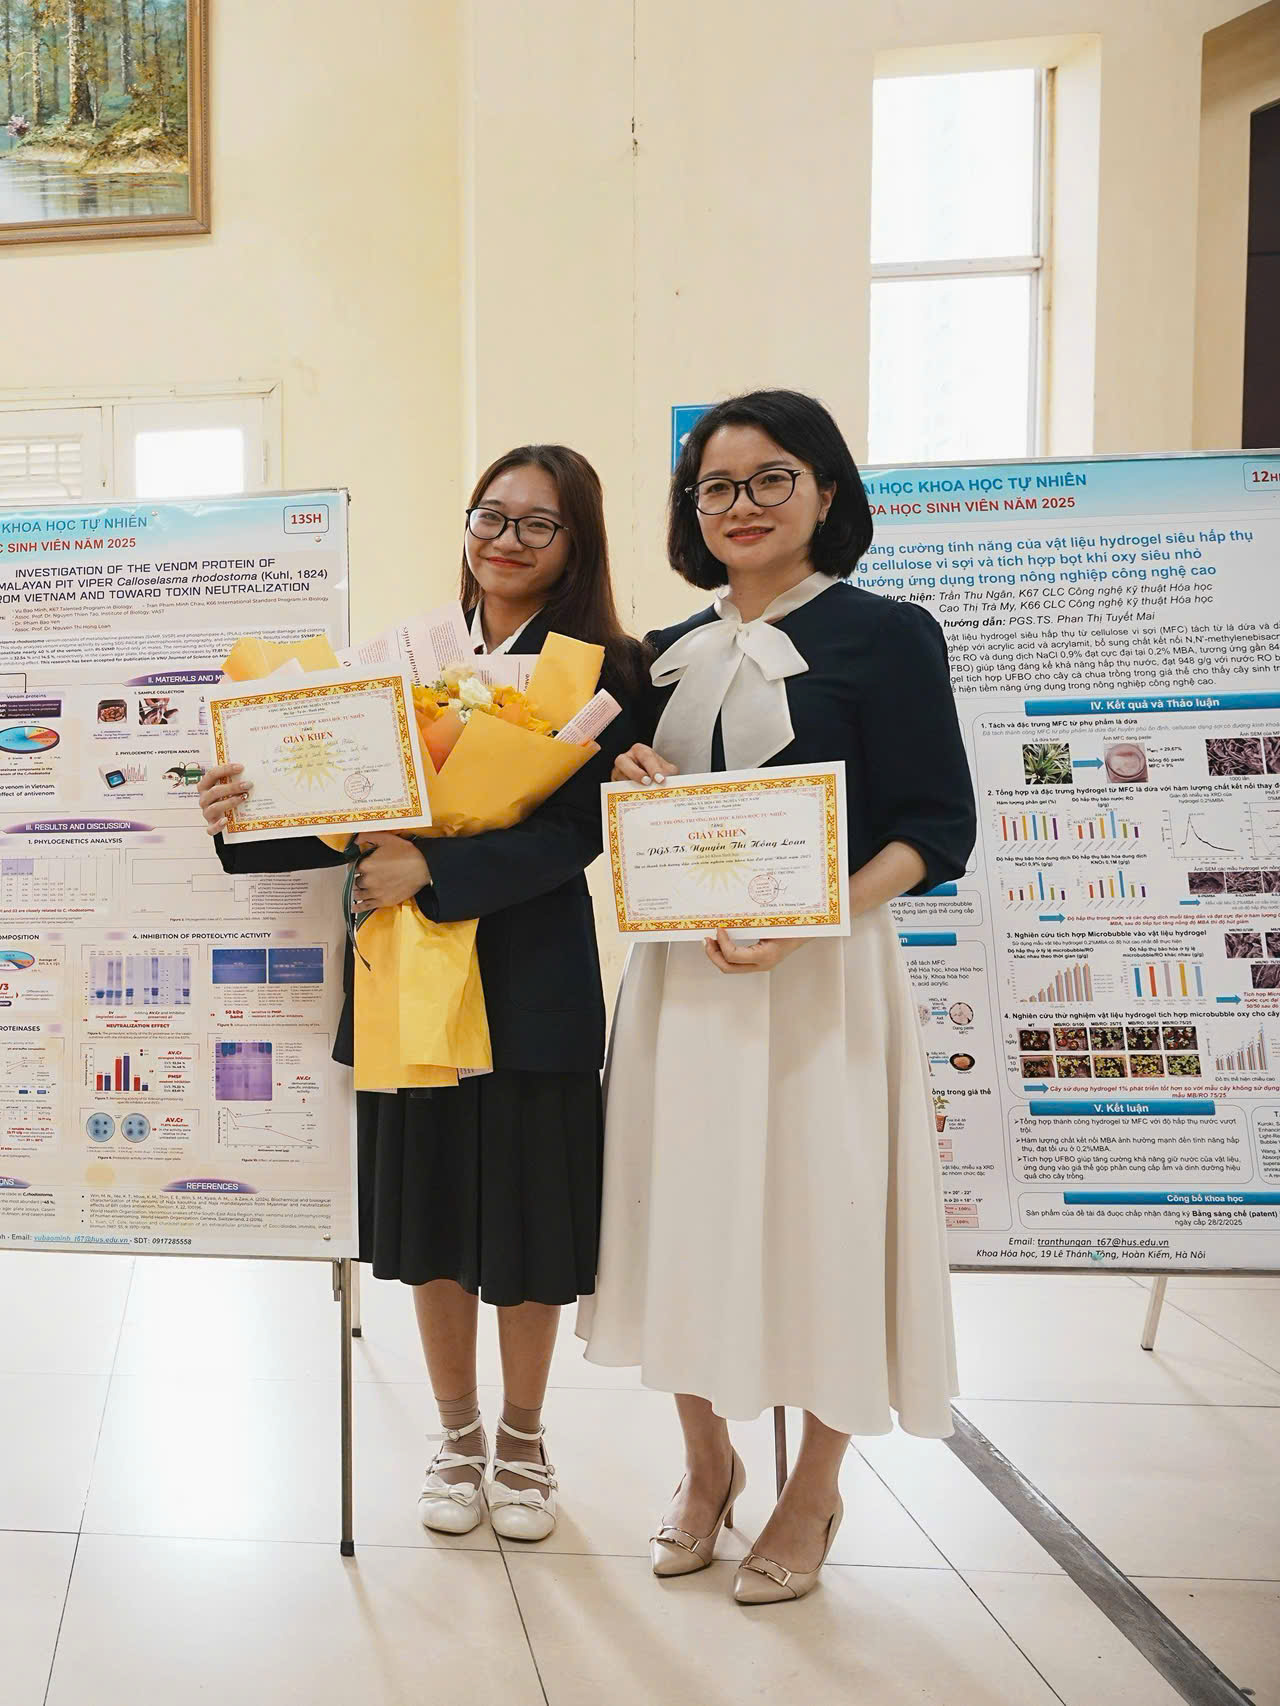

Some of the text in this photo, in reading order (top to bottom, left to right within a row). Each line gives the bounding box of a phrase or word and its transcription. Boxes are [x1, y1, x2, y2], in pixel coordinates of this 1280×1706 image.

[1252, 471, 1280, 482] 12H
[2, 522, 41, 534] KHOA
[46, 520, 76, 534] HỌC
[80, 518, 100, 532] TỰ
[104, 514, 147, 528] NHIÊN
[291, 514, 322, 524] 13SH
[872, 548, 1202, 571] cellulose vi sợi và tích hợp bọt khí oxy siêu nhỏ
[16, 558, 275, 578] INVESTIGATION OF THE VENOM PROTEIN OF
[55, 579, 74, 589] PIT
[78, 578, 113, 588] VIPER
[117, 574, 188, 586] Calloselasma
[191, 572, 257, 583] rhodostoma
[261, 570, 292, 582] (Kuhl,
[297, 569, 328, 580] 1824)
[24, 592, 76, 602] VIETNAM
[80, 590, 105, 600] AND
[109, 588, 161, 599] TOWARD
[165, 586, 201, 597] TOXIN
[205, 582, 310, 595] NEUTRALIZATION
[1090, 698, 1220, 710] IV. Kết quả và Thảo luận
[308, 732, 333, 741] KHEN
[716, 829, 747, 839] KHEN
[647, 845, 687, 856] PGS.TS.
[781, 838, 806, 846] Loan
[1106, 1104, 1124, 1112] Kết
[1126, 1104, 1149, 1113] luận
[187, 1182, 238, 1190] REFERENCES
[1009, 1238, 1169, 1248] Email: tranthungan_t67@hus.edu.vn
[977, 1250, 998, 1258] Khoa
[1000, 1250, 1018, 1258] Hóa
[1020, 1250, 1038, 1259] học,
[1054, 1250, 1063, 1258] Lê
[1066, 1250, 1092, 1259] Thánh
[1122, 1251, 1146, 1259] Hoàn
[1148, 1250, 1172, 1260] Kiếm,
[1176, 1251, 1187, 1259] Hà
